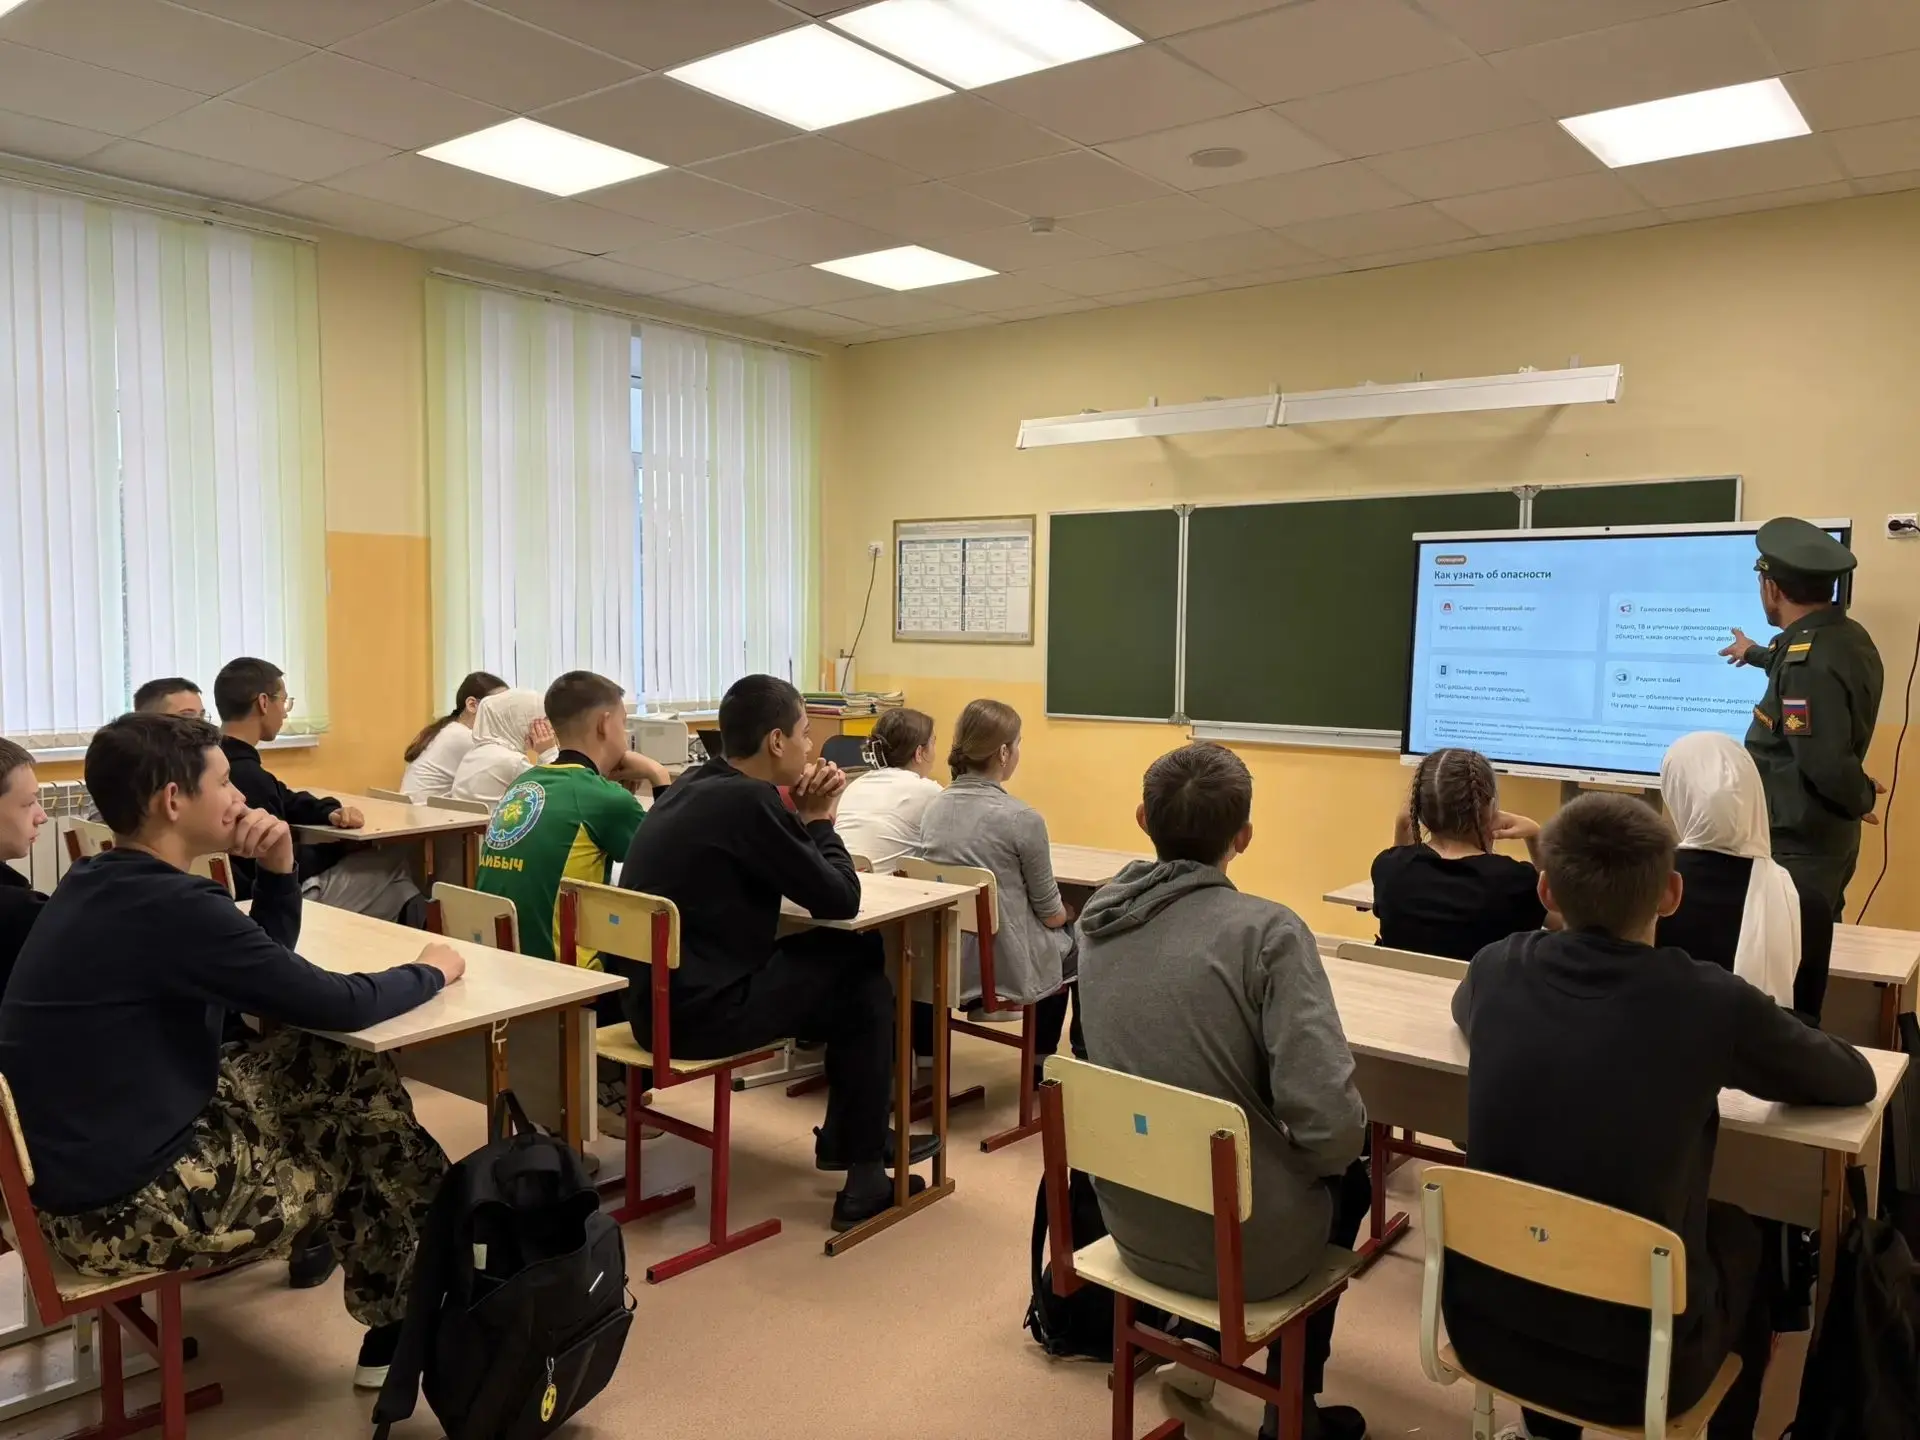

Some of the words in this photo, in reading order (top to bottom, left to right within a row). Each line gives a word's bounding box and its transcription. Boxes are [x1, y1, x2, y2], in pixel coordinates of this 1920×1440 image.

[1434, 570, 1451, 580] Как
[1453, 571, 1484, 581] узнать
[1486, 569, 1499, 579] об
[1501, 571, 1552, 579] опасности
[1674, 606, 1711, 614] сообщение
[1615, 623, 1637, 631] Радио,
